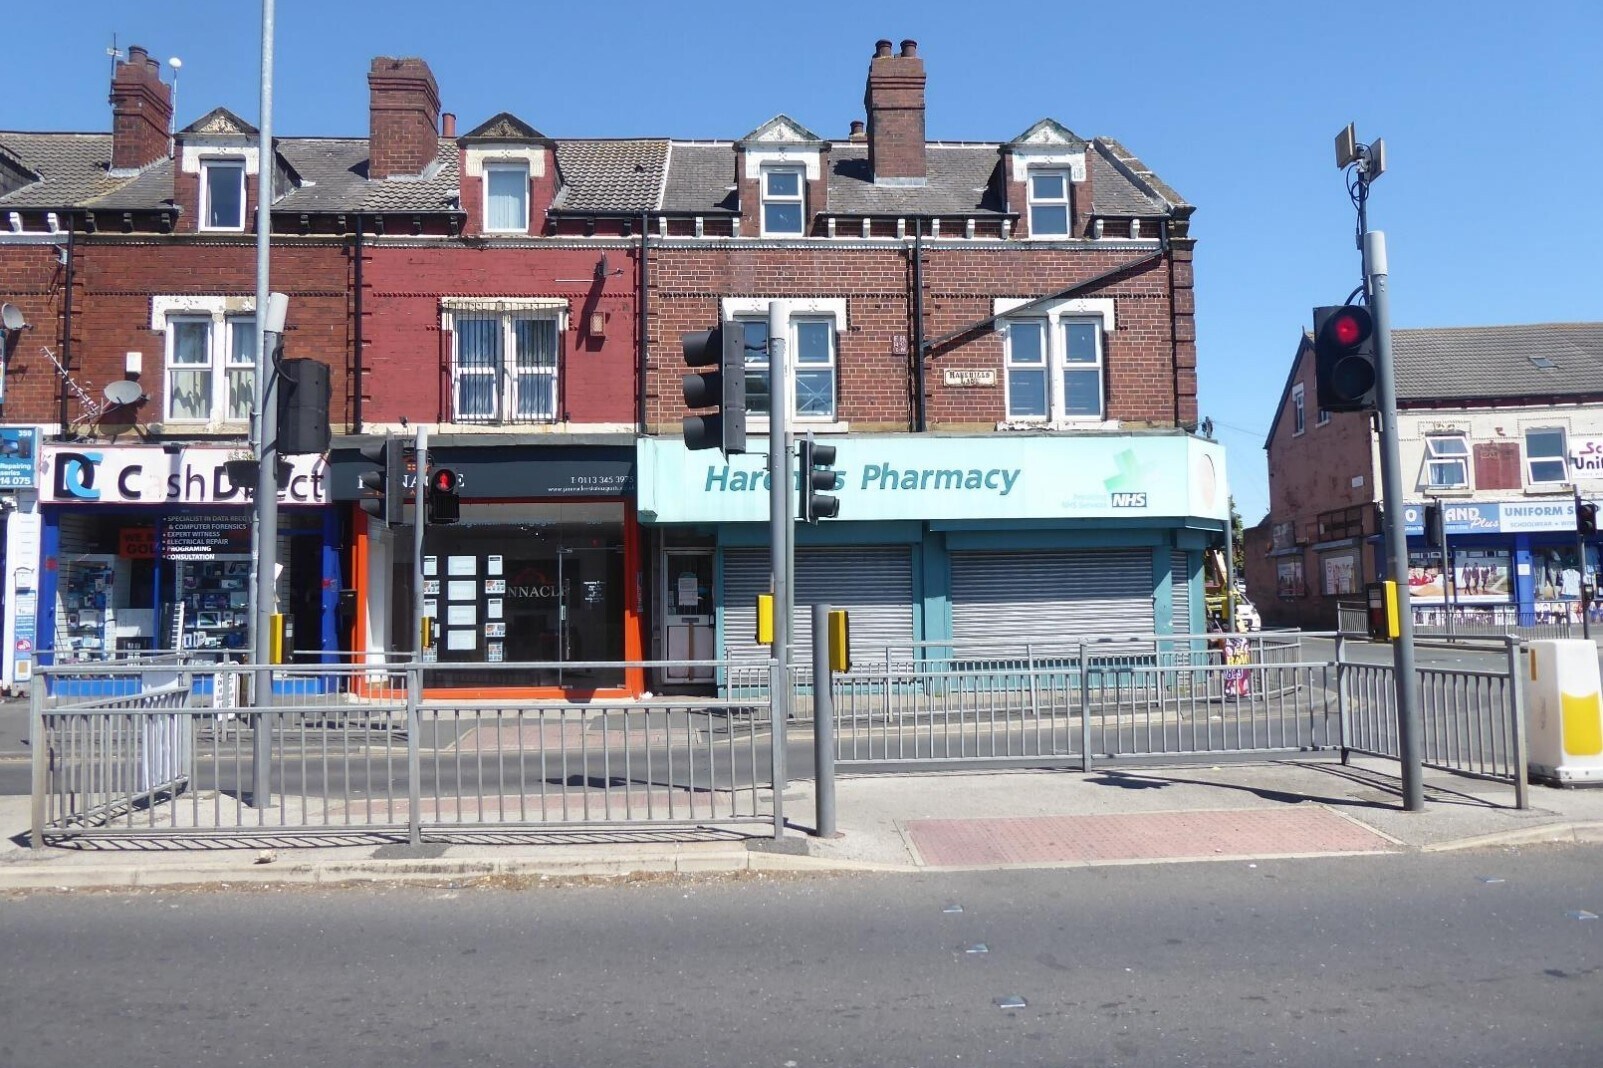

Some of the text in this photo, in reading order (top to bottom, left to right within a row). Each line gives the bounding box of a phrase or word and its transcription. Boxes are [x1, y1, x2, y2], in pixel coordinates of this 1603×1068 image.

[12, 477, 31, 485] 075
[577, 476, 597, 484] 0113
[599, 475, 614, 484] 345
[860, 462, 1021, 496] Pharmacy
[1113, 494, 1145, 506] NHS
[1505, 506, 1563, 517] UNIFORM
[1470, 517, 1498, 529] Plus
